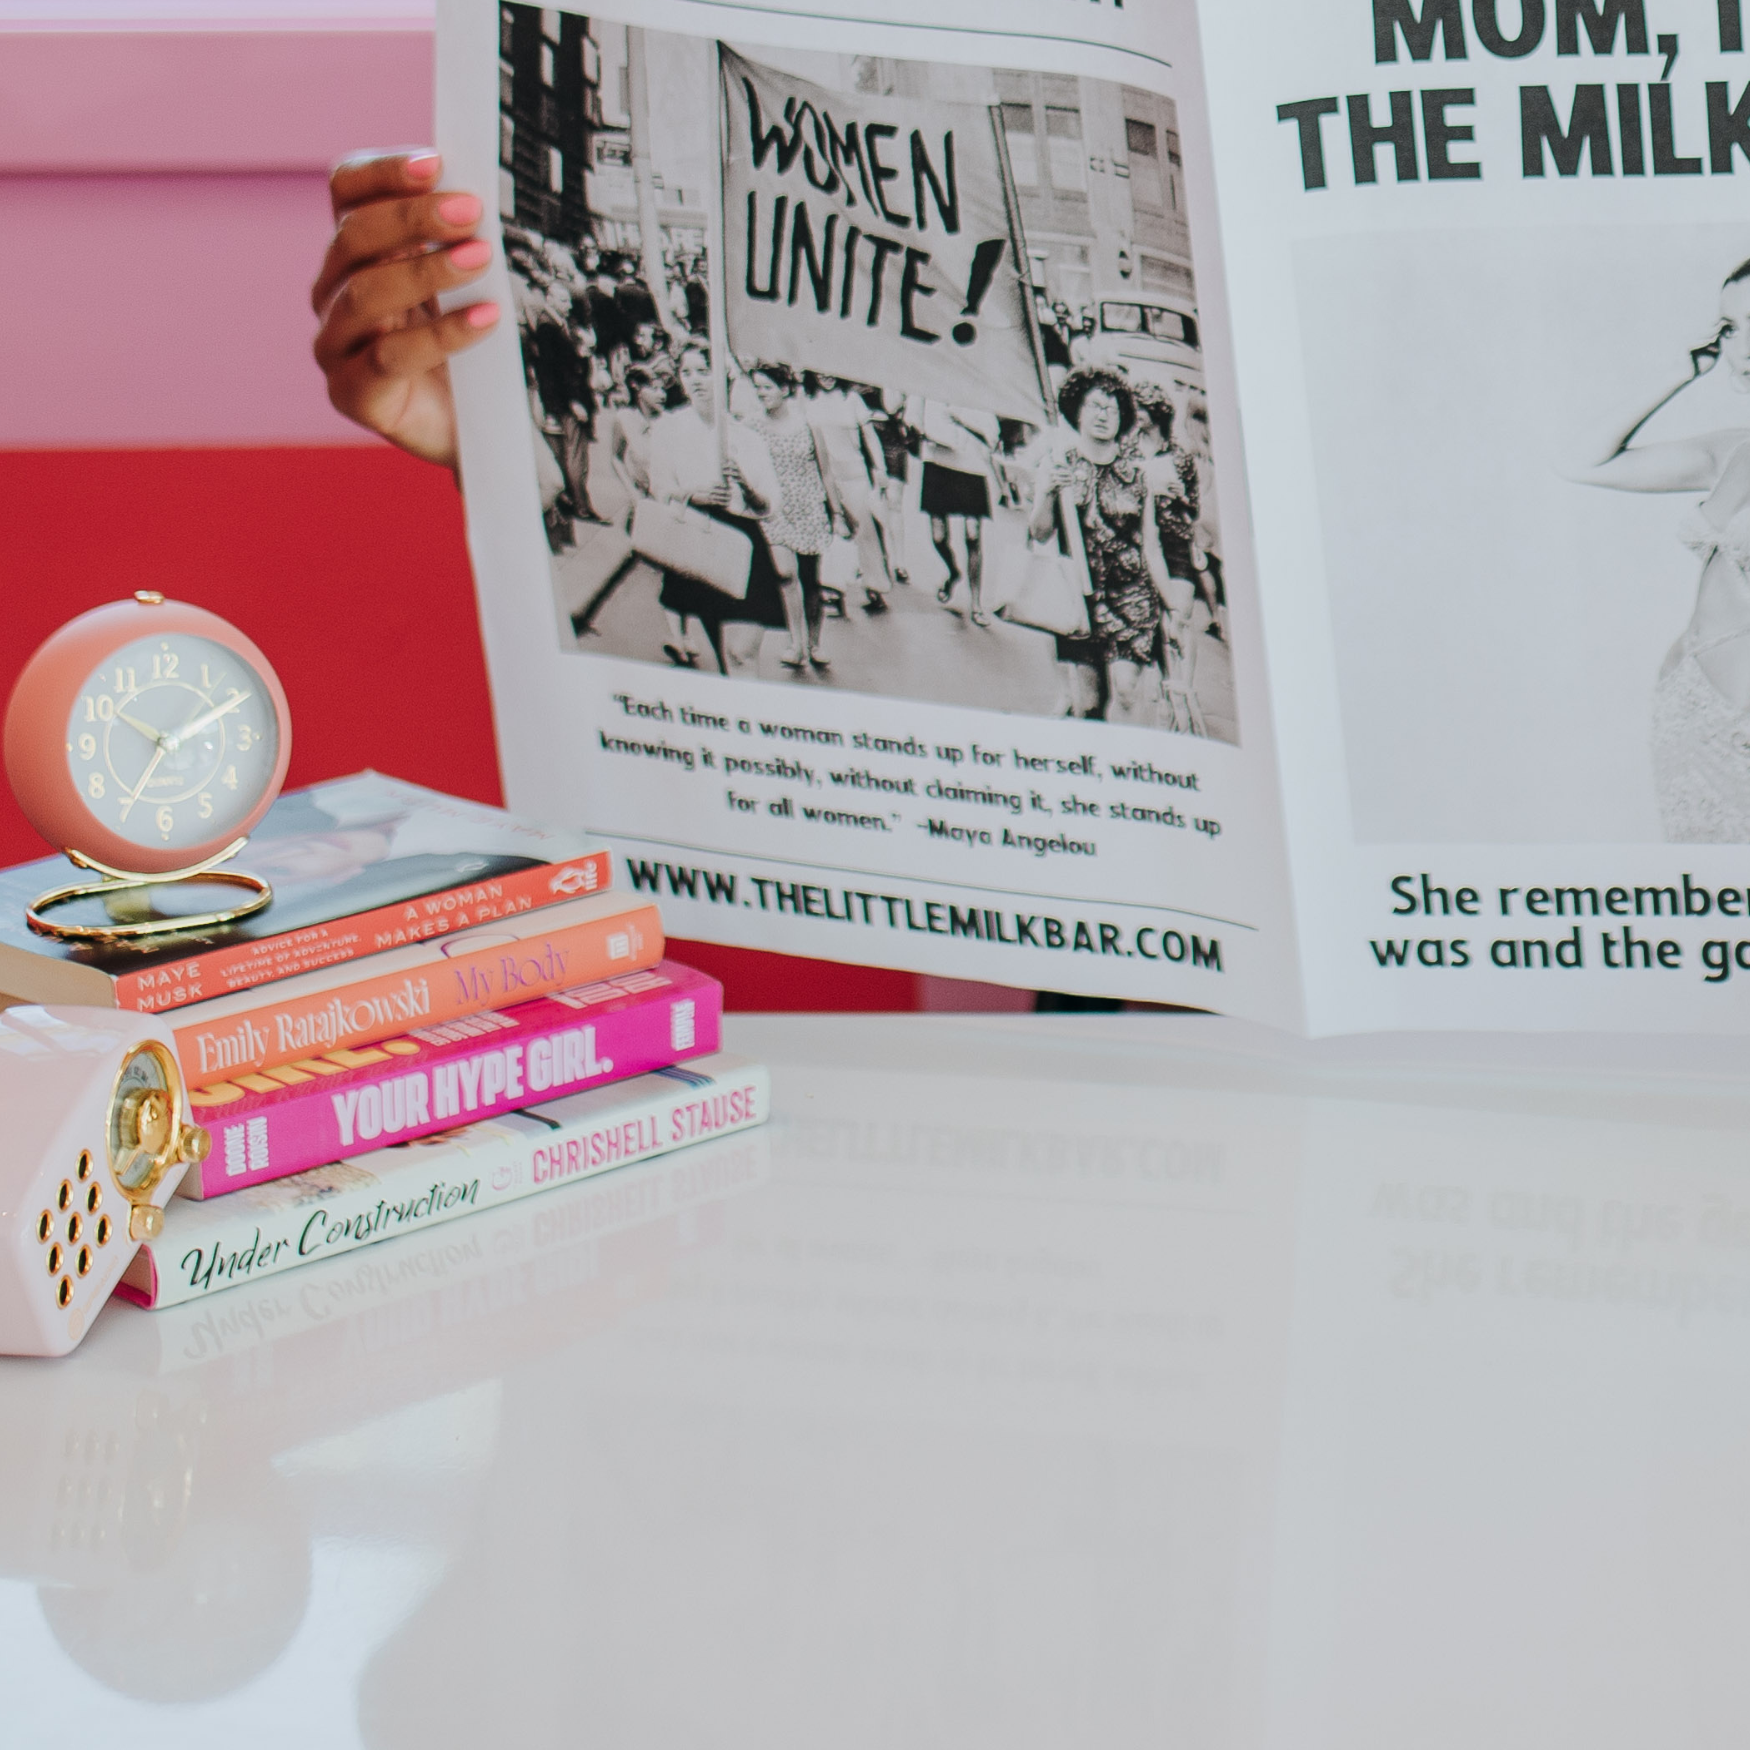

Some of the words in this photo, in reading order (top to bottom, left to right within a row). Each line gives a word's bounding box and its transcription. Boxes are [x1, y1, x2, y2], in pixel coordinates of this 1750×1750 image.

[741, 75, 962, 235] WOMEN
[1275, 87, 1482, 193] THE
[745, 191, 1006, 345] UNITE!
[114, 667, 135, 693] 11
[153, 653, 179, 679] 12
[201, 664, 211, 688] 1
[82, 694, 114, 722] 10
[78, 733, 96, 760] 9
[237, 725, 252, 751] 3
[613, 692, 675, 722] “Each
[680, 706, 730, 732] time
[737, 718, 751, 733] a
[760, 720, 843, 746] woman
[852, 732, 929, 759] stands
[935, 742, 965, 766] up
[971, 743, 1006, 767] for
[1013, 750, 1103, 779] herself,
[1110, 759, 1200, 791] without
[88, 772, 105, 799] 8
[222, 765, 237, 790] 4
[599, 730, 695, 771] knowing
[700, 744, 717, 768] it
[724, 754, 823, 788] possibly,
[829, 766, 918, 797] without
[926, 777, 1023, 814] claiming
[1029, 789, 1053, 818] it,
[1060, 793, 1101, 819] she
[1109, 800, 1186, 831] stands
[1193, 813, 1222, 839] up
[118, 797, 135, 823] 7
[156, 806, 173, 832] 6
[198, 792, 213, 818] 5
[726, 790, 763, 815] for
[768, 794, 795, 819] all
[803, 804, 903, 833] women.”
[916, 815, 993, 848] -Maya
[1001, 827, 1097, 858] Angelou
[405, 903, 420, 921] A
[425, 885, 504, 916] WOMAN
[626, 855, 1224, 974] WWW.THELITTLEMILKBAR.COM
[1390, 872, 1479, 918] She
[375, 922, 451, 949] MAKES
[457, 911, 471, 926] A
[475, 896, 533, 922] PLAN
[1370, 935, 1470, 970] was
[1490, 926, 1583, 970] and
[1600, 926, 1684, 972] the
[137, 962, 202, 992] MAYE
[453, 968, 494, 1006] My
[500, 943, 571, 993] Body
[137, 983, 203, 1013] MUSK
[196, 1018, 270, 1074] Emily
[275, 977, 430, 1053] Ratajkowski
[331, 1071, 430, 1146] YOUR
[432, 1044, 526, 1120] HYPE
[527, 1025, 613, 1091] GIRL.
[532, 1116, 663, 1184] CHRISHELL
[671, 1084, 757, 1144] STAUSE
[180, 1227, 290, 1289] Under
[298, 1177, 481, 1256] Construction
